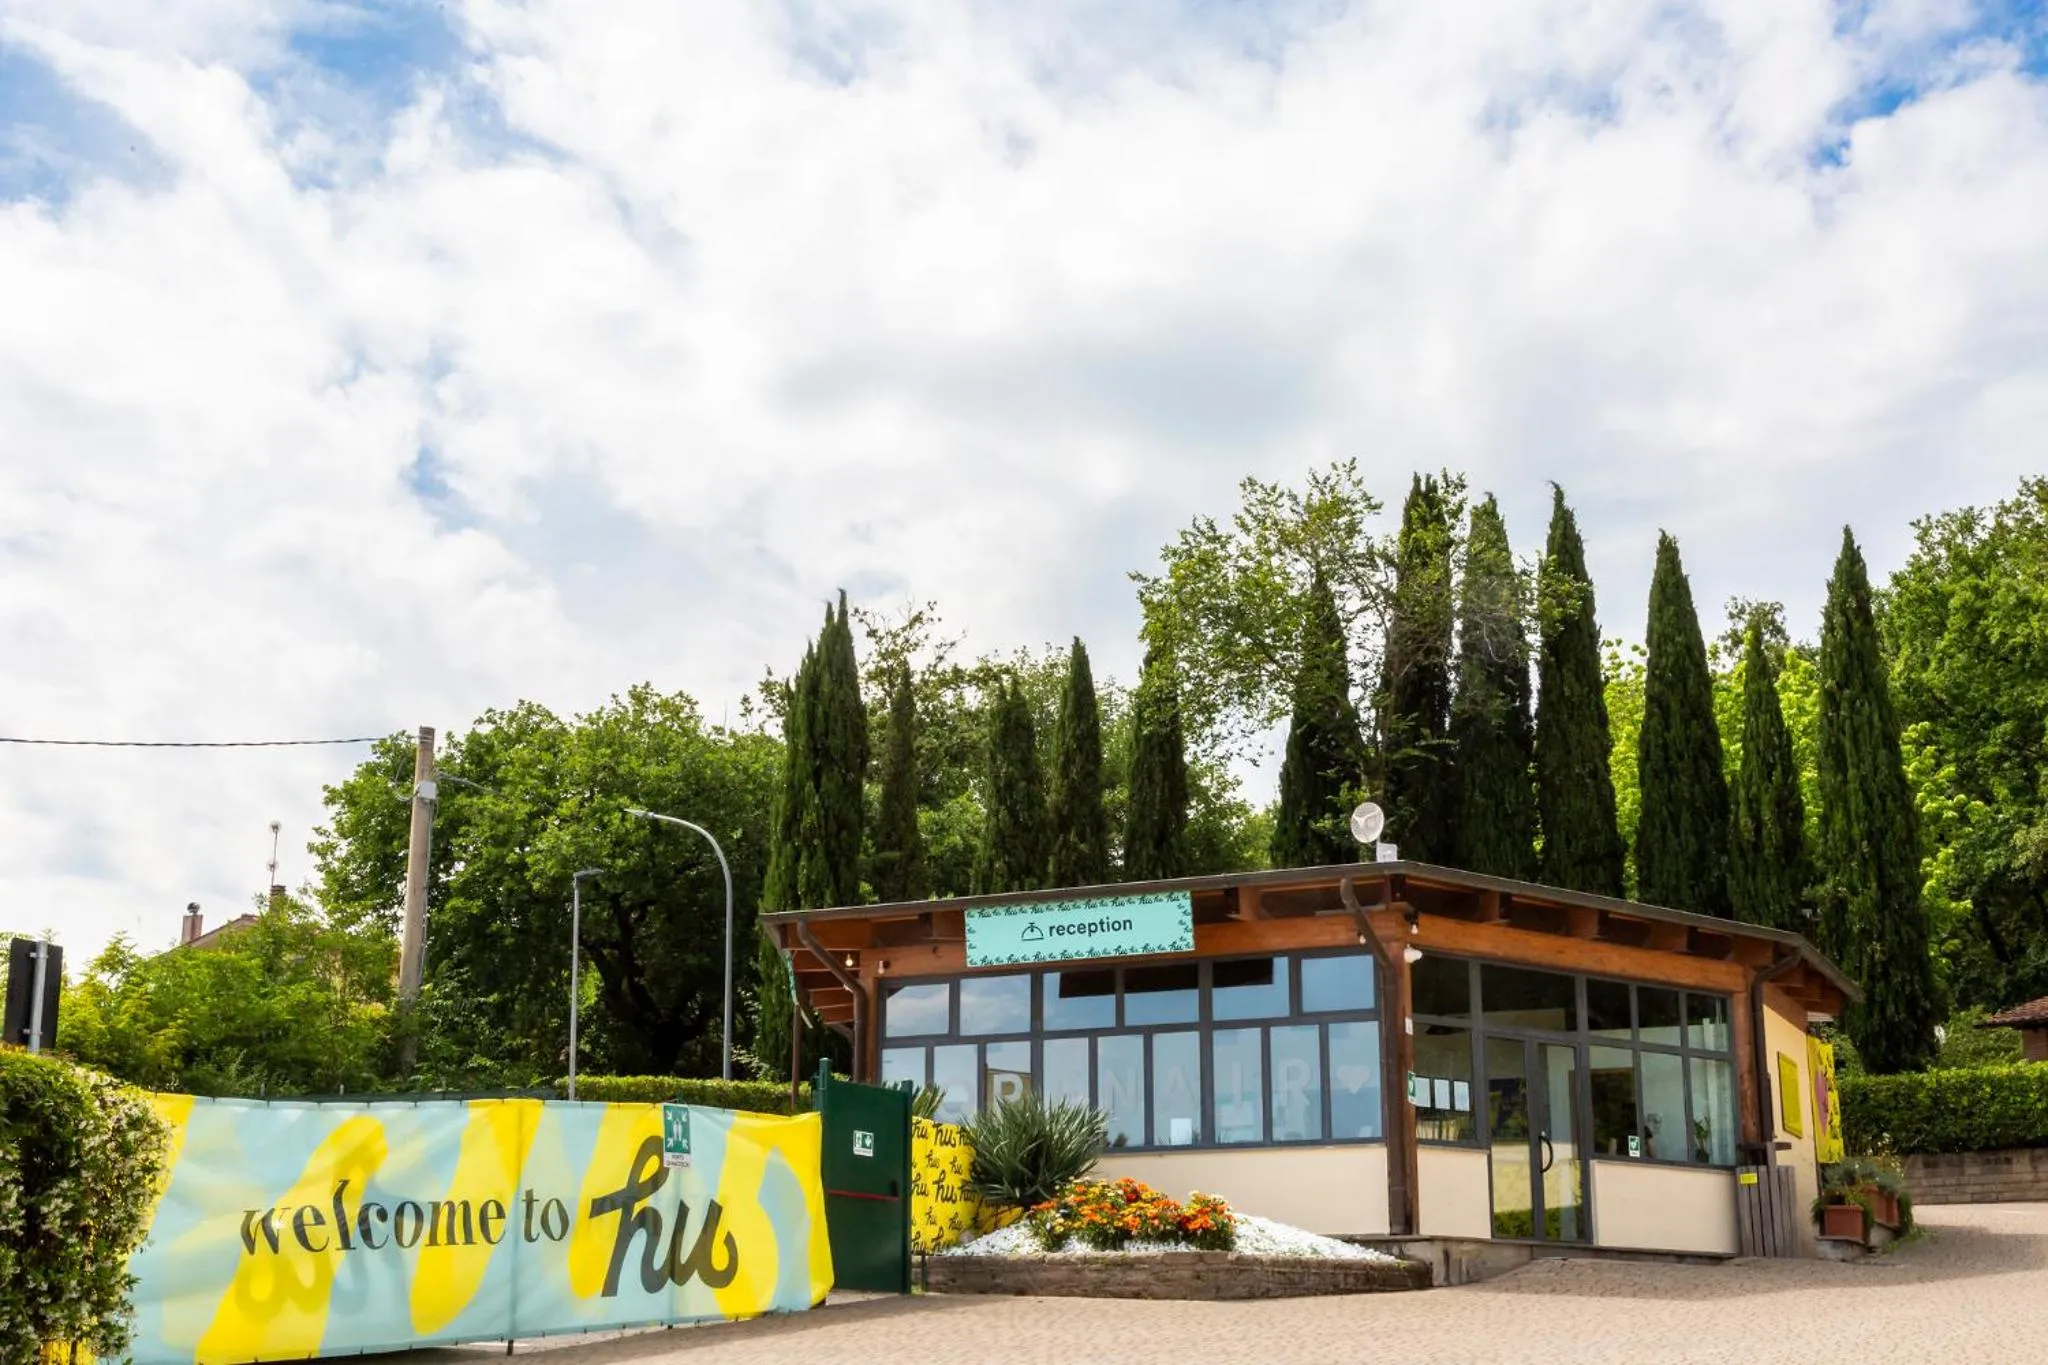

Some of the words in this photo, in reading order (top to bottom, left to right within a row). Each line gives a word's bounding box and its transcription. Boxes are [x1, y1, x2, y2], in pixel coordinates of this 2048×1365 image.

[1048, 916, 1133, 937] reception
[932, 1169, 957, 1204] hu
[240, 1178, 506, 1256] welcome
[521, 1187, 570, 1243] to
[589, 1135, 739, 1297] hu
